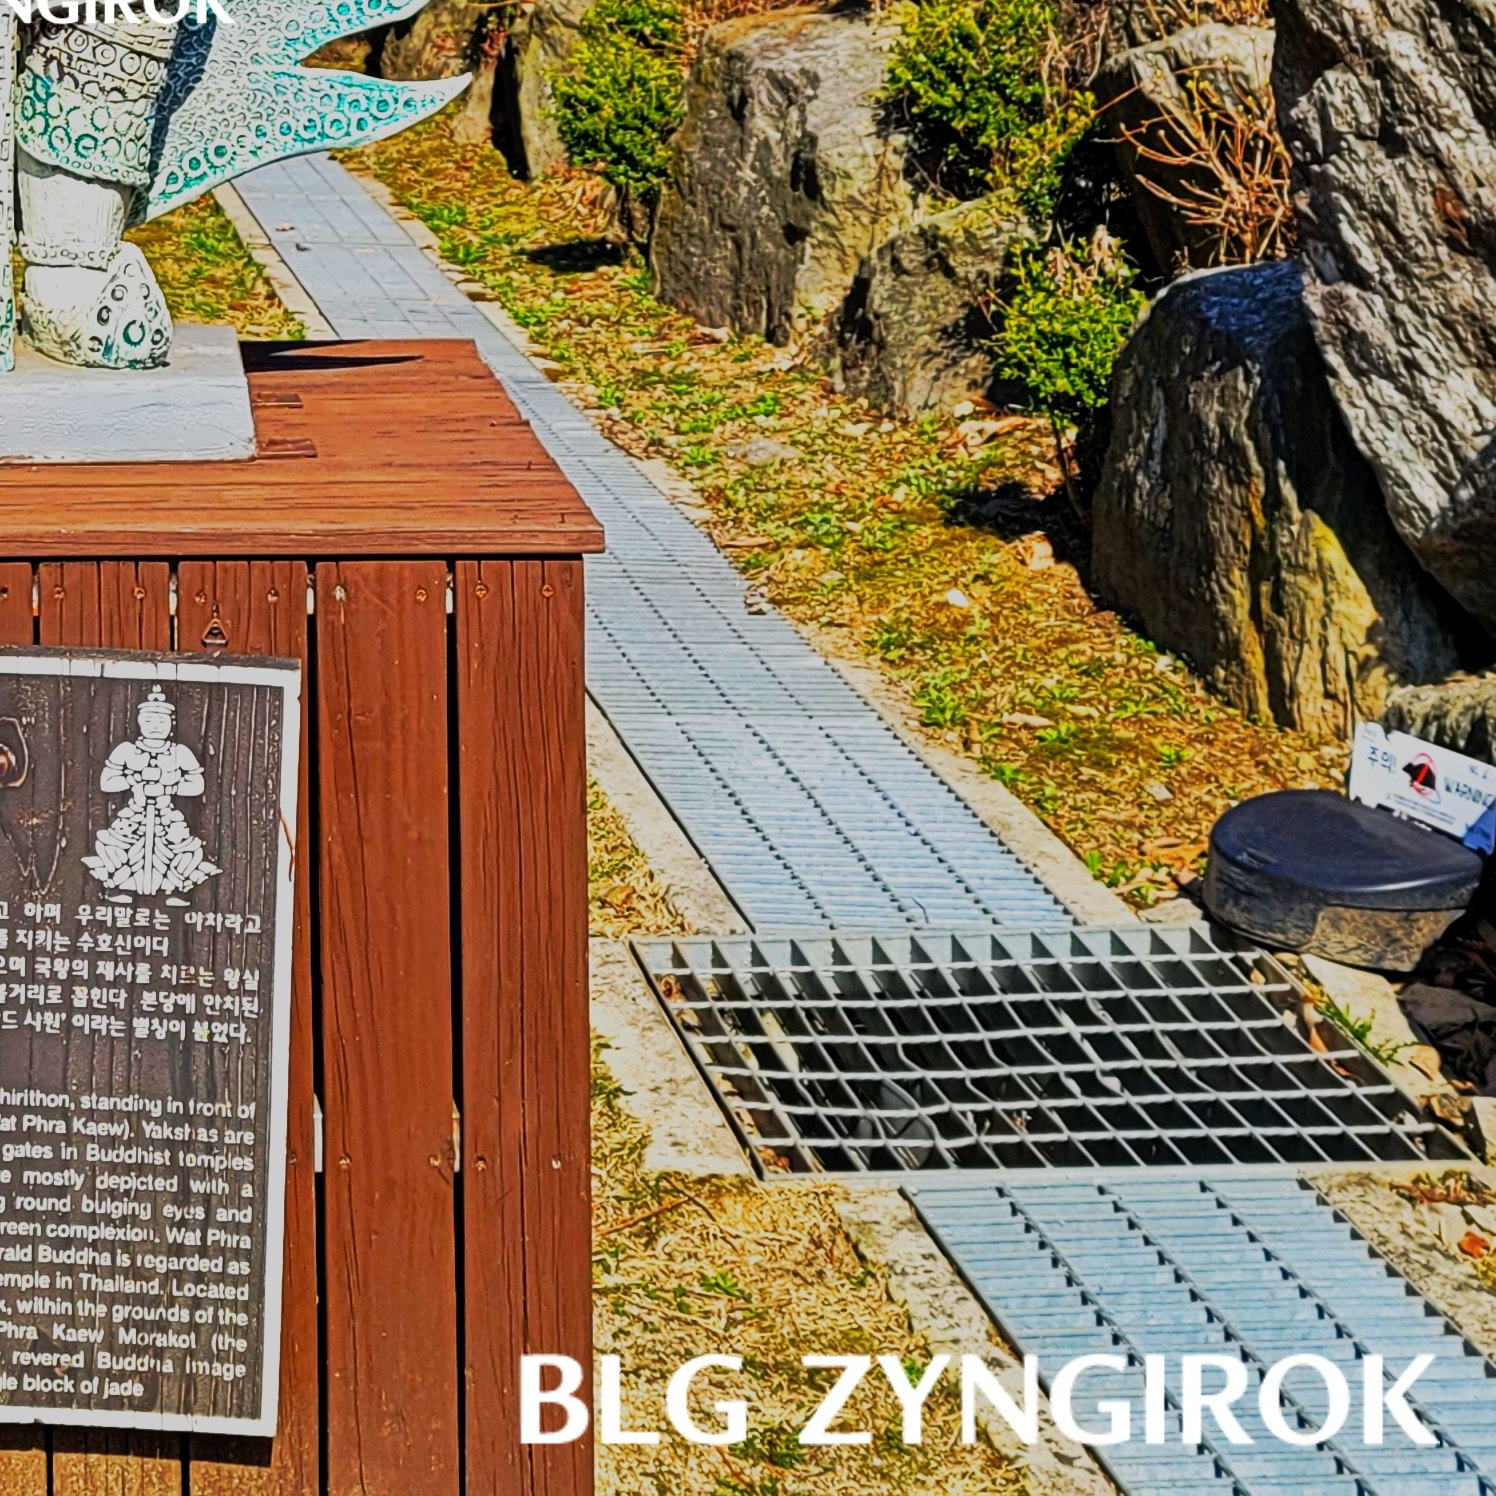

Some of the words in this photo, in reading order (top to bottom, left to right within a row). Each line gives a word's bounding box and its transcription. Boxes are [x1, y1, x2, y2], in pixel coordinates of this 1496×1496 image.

[23, 902, 62, 925] 하며
[74, 904, 171, 931] 우리말로는
[15, 929, 71, 952] 지키는
[76, 931, 169, 957] 수호신이다
[34, 956, 89, 980] 국왕의
[96, 960, 152, 984] 제사를
[223, 968, 260, 991] 왕실
[140, 990, 196, 1014] 본당에
[71, 1014, 126, 1037] 이라는
[132, 1017, 186, 1041] 별칭이
[80, 1092, 162, 1118] standing
[167, 1095, 184, 1114] in
[188, 1098, 232, 1118] front
[237, 1097, 256, 1119] of
[22, 1114, 67, 1134] Phra
[72, 1116, 135, 1140] Kaew).
[142, 1120, 219, 1143] Yakshas
[224, 1129, 255, 1145] are
[2, 1141, 54, 1162] gates
[60, 1141, 78, 1160] in
[86, 1143, 171, 1166] Buddhist
[178, 1149, 254, 1173] temples
[23, 1168, 85, 1191] mostly
[95, 1171, 178, 1197] depicted
[189, 1177, 229, 1195] with
[241, 1183, 253, 1198] a
[81, 1193, 152, 1220] bulging
[162, 1204, 206, 1221] eyes
[215, 1206, 253, 1223] and
[46, 1222, 161, 1243] complexion.
[165, 1226, 202, 1246] Wat
[207, 1228, 251, 1249] Phra
[37, 1244, 112, 1266] Buddha
[116, 1249, 131, 1267] is
[136, 1253, 223, 1274] regarded
[227, 1261, 251, 1275] as
[55, 1271, 73, 1289] in
[172, 1278, 249, 1301] Located
[16, 1296, 73, 1315] within
[76, 1299, 108, 1318] the
[112, 1304, 190, 1323] grounds
[195, 1306, 214, 1324] of
[217, 1308, 249, 1326] the
[52, 1322, 104, 1344] Kaew
[118, 1326, 197, 1349] Morakot
[211, 1333, 247, 1354] (the
[12, 1351, 85, 1368] revered
[97, 1351, 174, 1373] Buddha
[23, 1373, 75, 1393] block
[80, 1376, 99, 1394] of
[103, 1377, 145, 1399] jade
